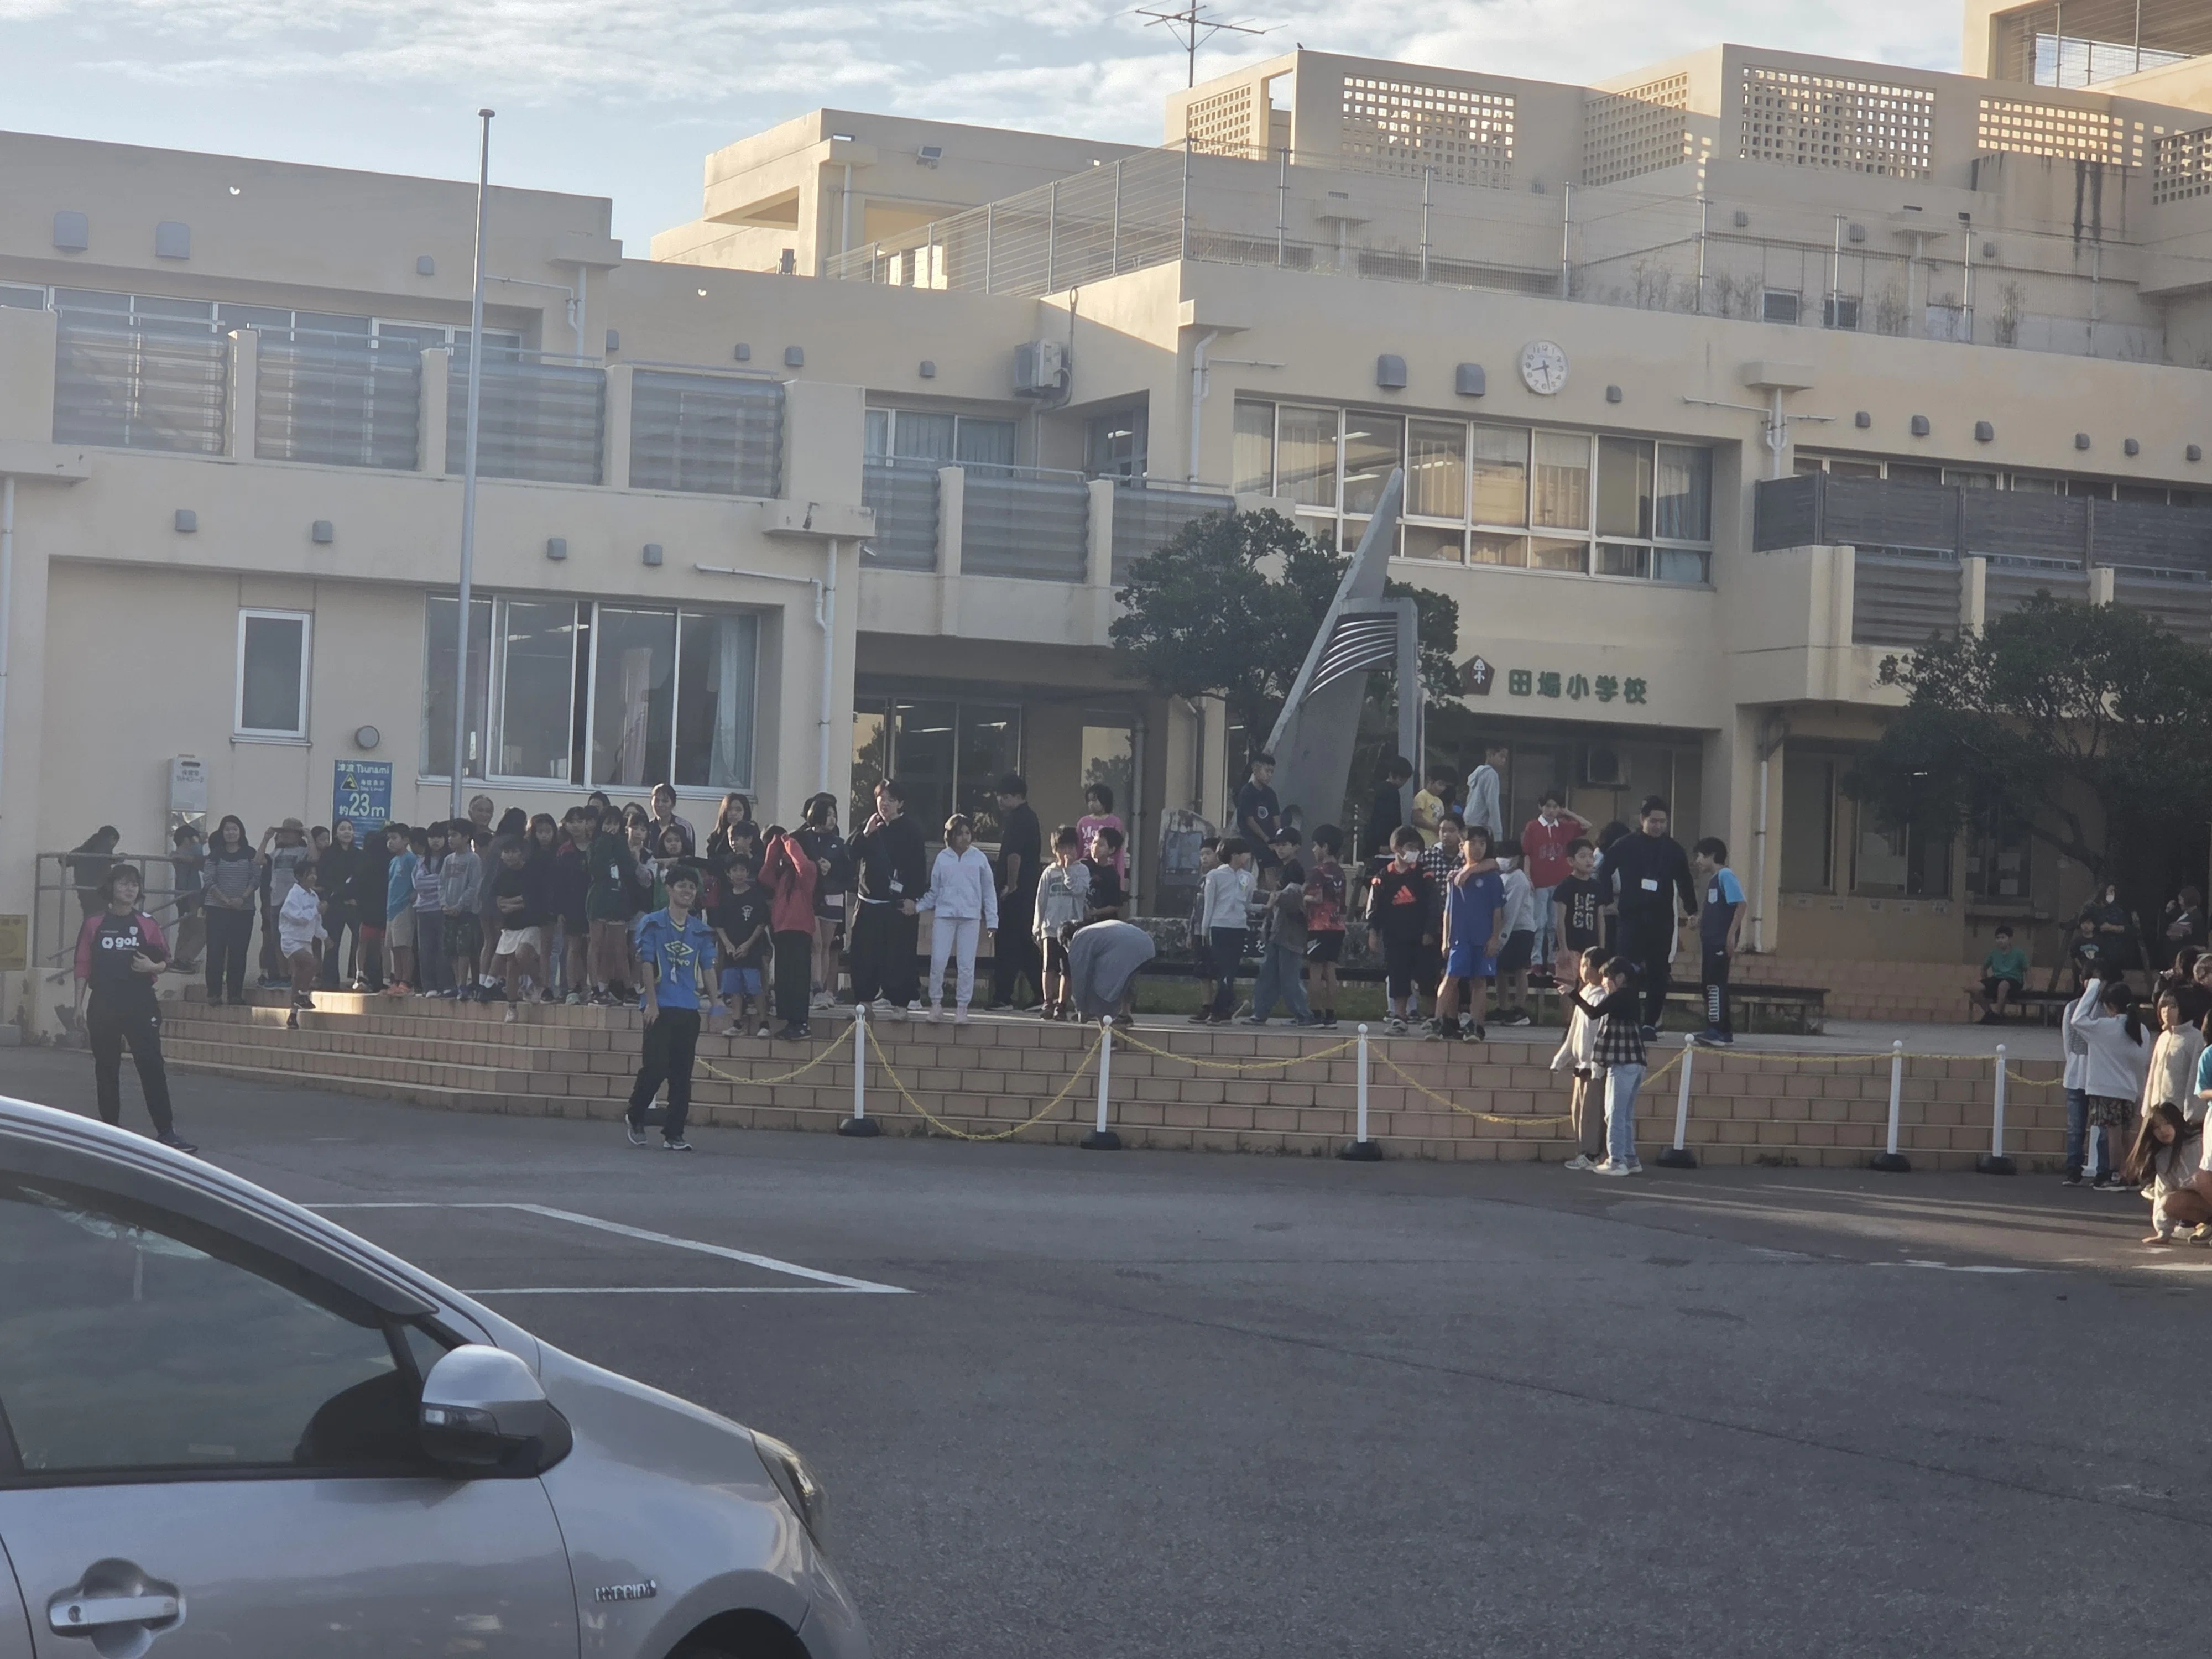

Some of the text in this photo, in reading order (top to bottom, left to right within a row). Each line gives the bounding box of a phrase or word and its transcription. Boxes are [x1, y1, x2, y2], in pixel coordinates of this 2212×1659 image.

[1508, 669, 1647, 705] 田場小学校
[356, 764, 389, 774] Tsunami
